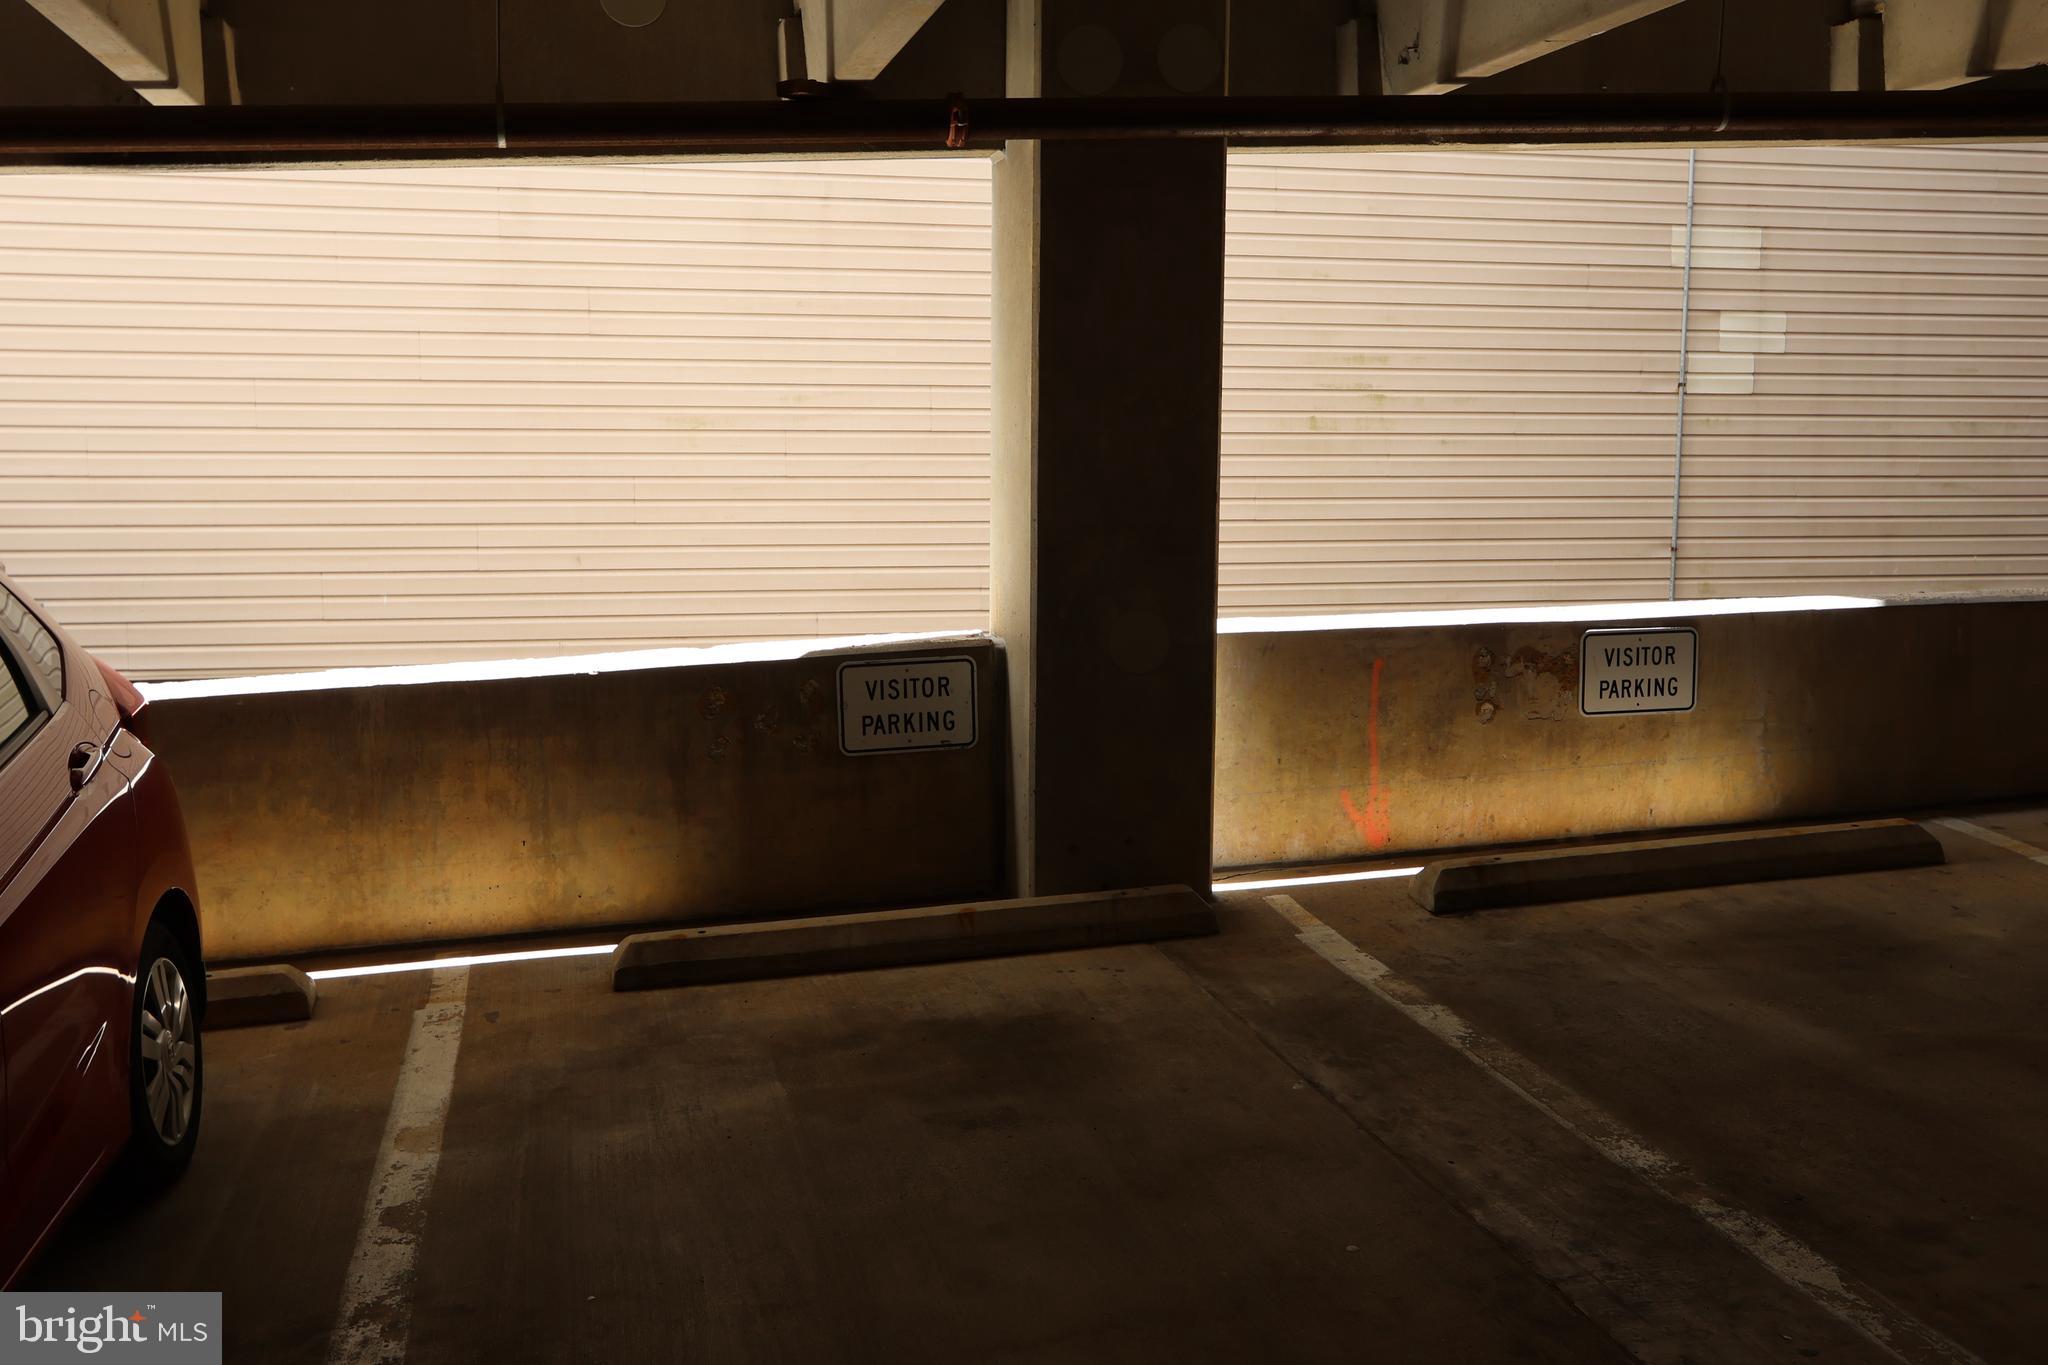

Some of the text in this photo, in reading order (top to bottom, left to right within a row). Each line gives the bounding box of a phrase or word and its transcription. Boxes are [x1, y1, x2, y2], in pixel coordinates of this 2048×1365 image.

[1604, 646, 1676, 667] VISITOR
[865, 677, 950, 701] VISITOR
[1599, 677, 1678, 699] PARKING
[862, 710, 955, 736] PARKING
